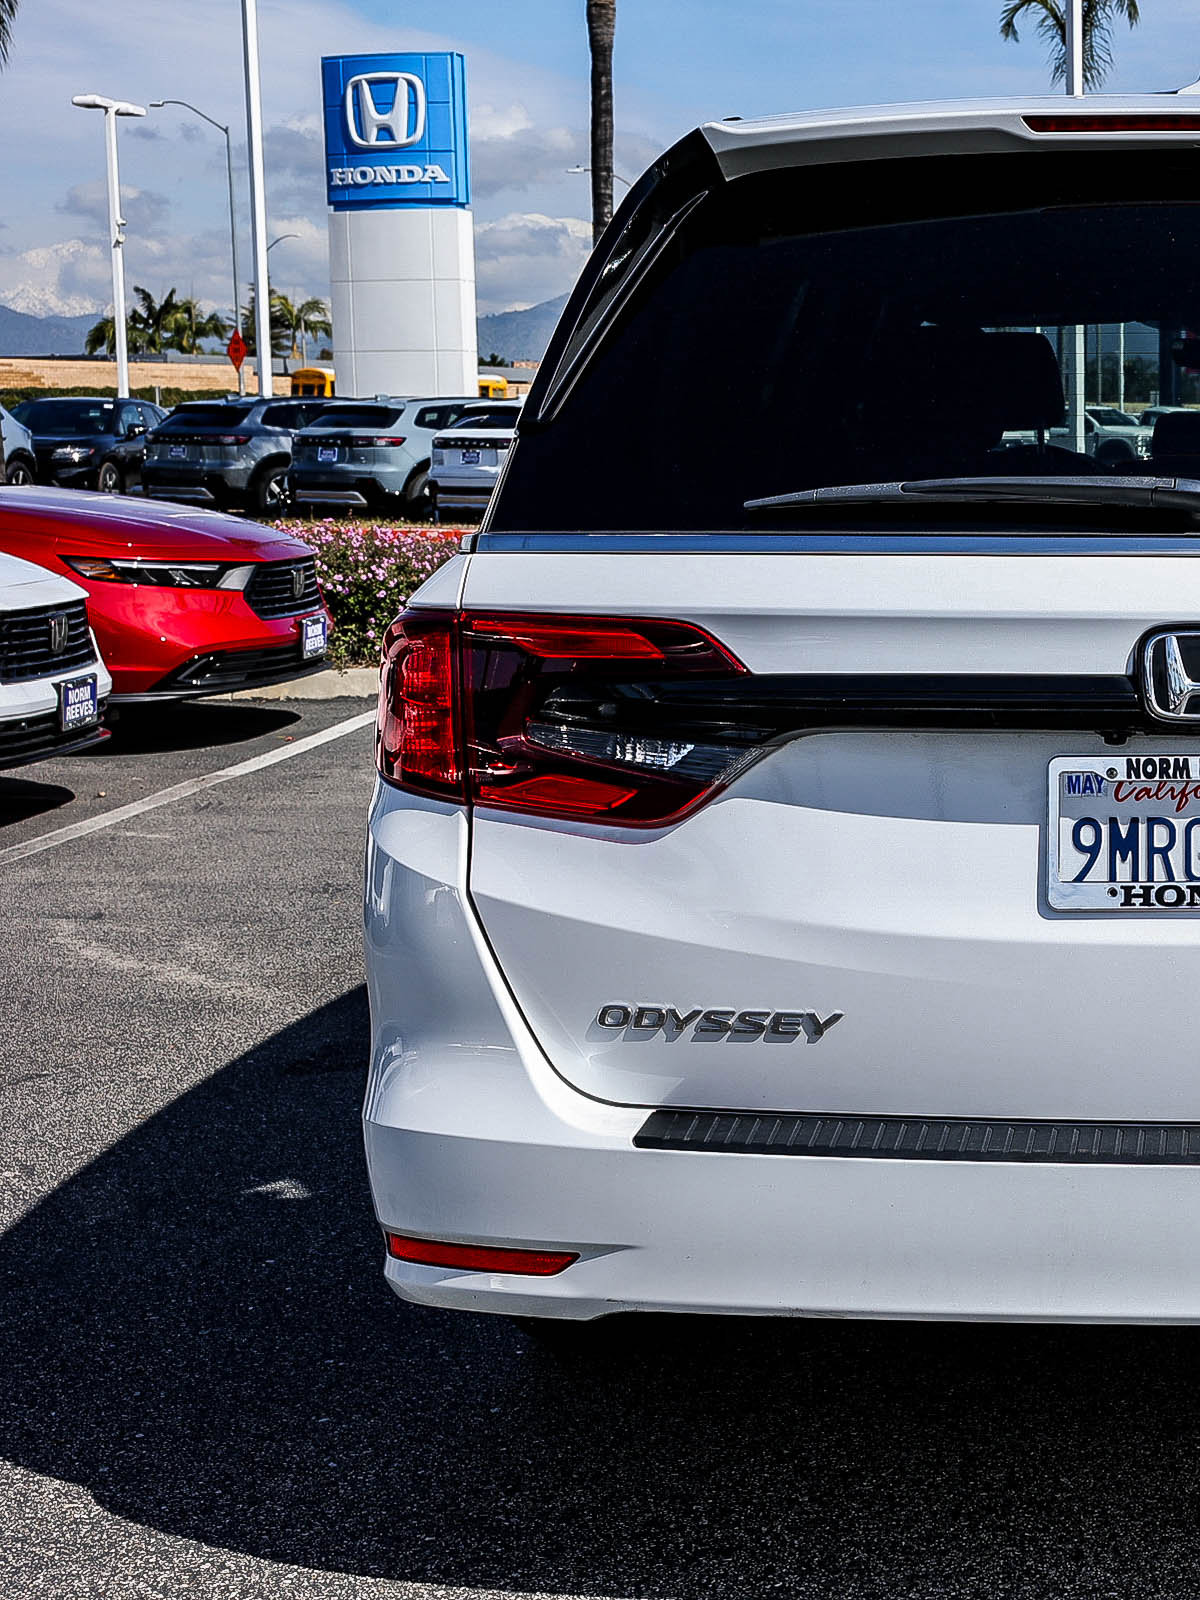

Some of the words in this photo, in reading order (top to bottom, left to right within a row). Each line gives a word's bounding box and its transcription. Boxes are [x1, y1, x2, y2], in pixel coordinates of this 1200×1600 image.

[330, 165, 450, 186] HONDA
[68, 685, 91, 705] NORM
[66, 699, 94, 721] REEVES
[1126, 757, 1192, 779] NORM
[1067, 775, 1104, 795] MAY
[597, 1003, 845, 1036] ODYSSEY
